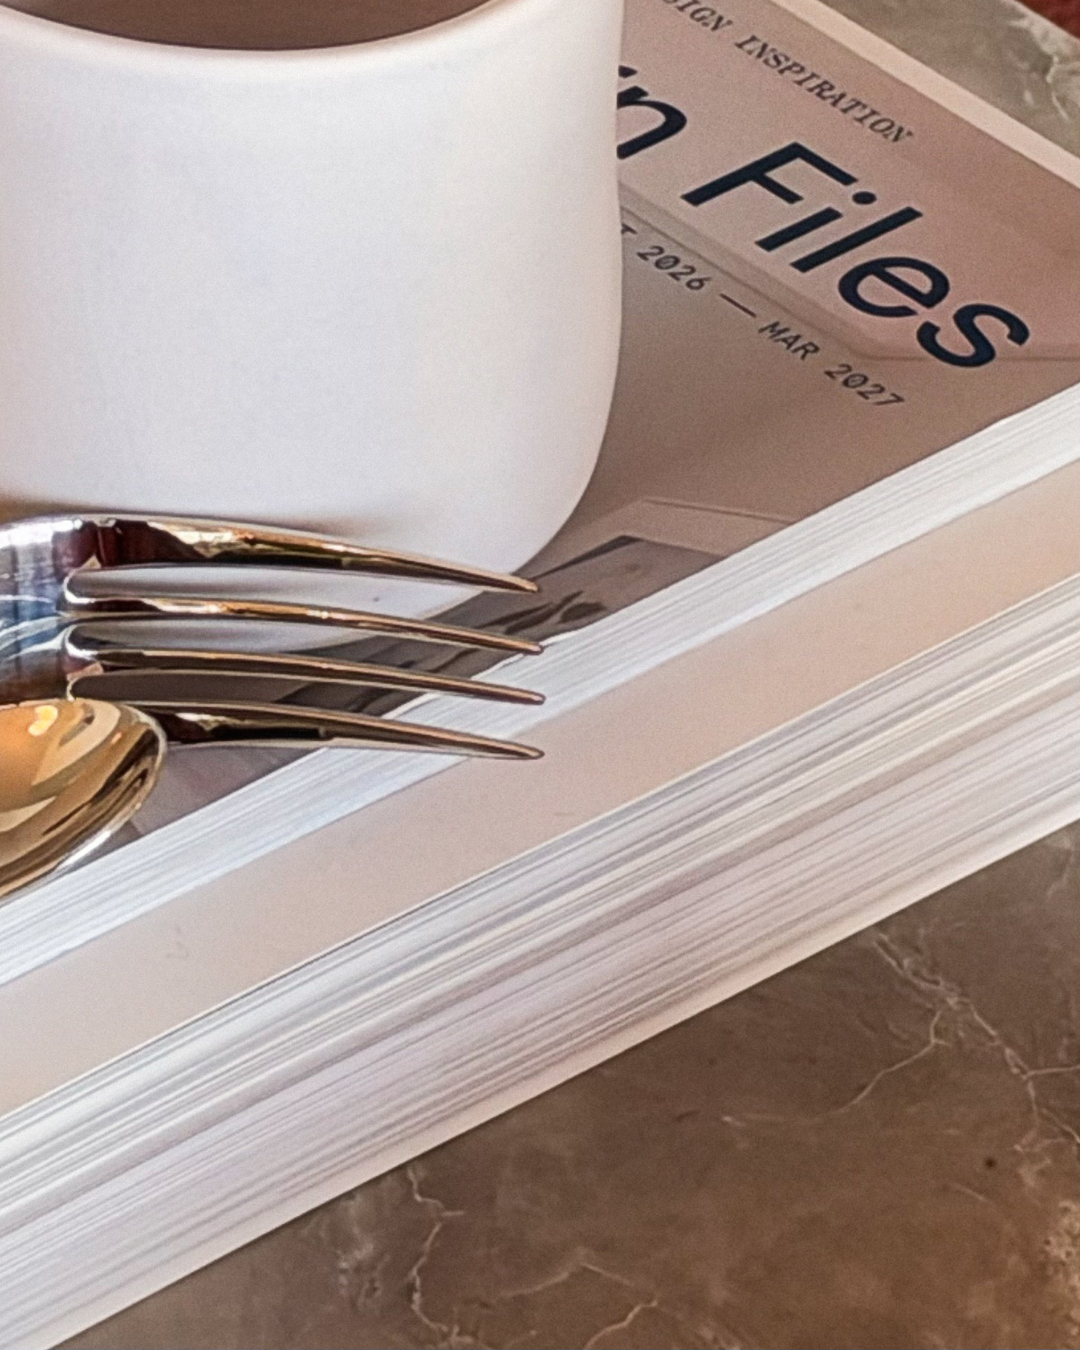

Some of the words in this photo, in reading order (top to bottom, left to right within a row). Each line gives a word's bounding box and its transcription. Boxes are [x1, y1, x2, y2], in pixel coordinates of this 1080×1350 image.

[735, 34, 915, 145] INSPIRATION
[636, 245, 712, 291] 2026
[758, 320, 820, 362] MAR
[824, 363, 905, 408] 2027
[680, 141, 1030, 368] Files
